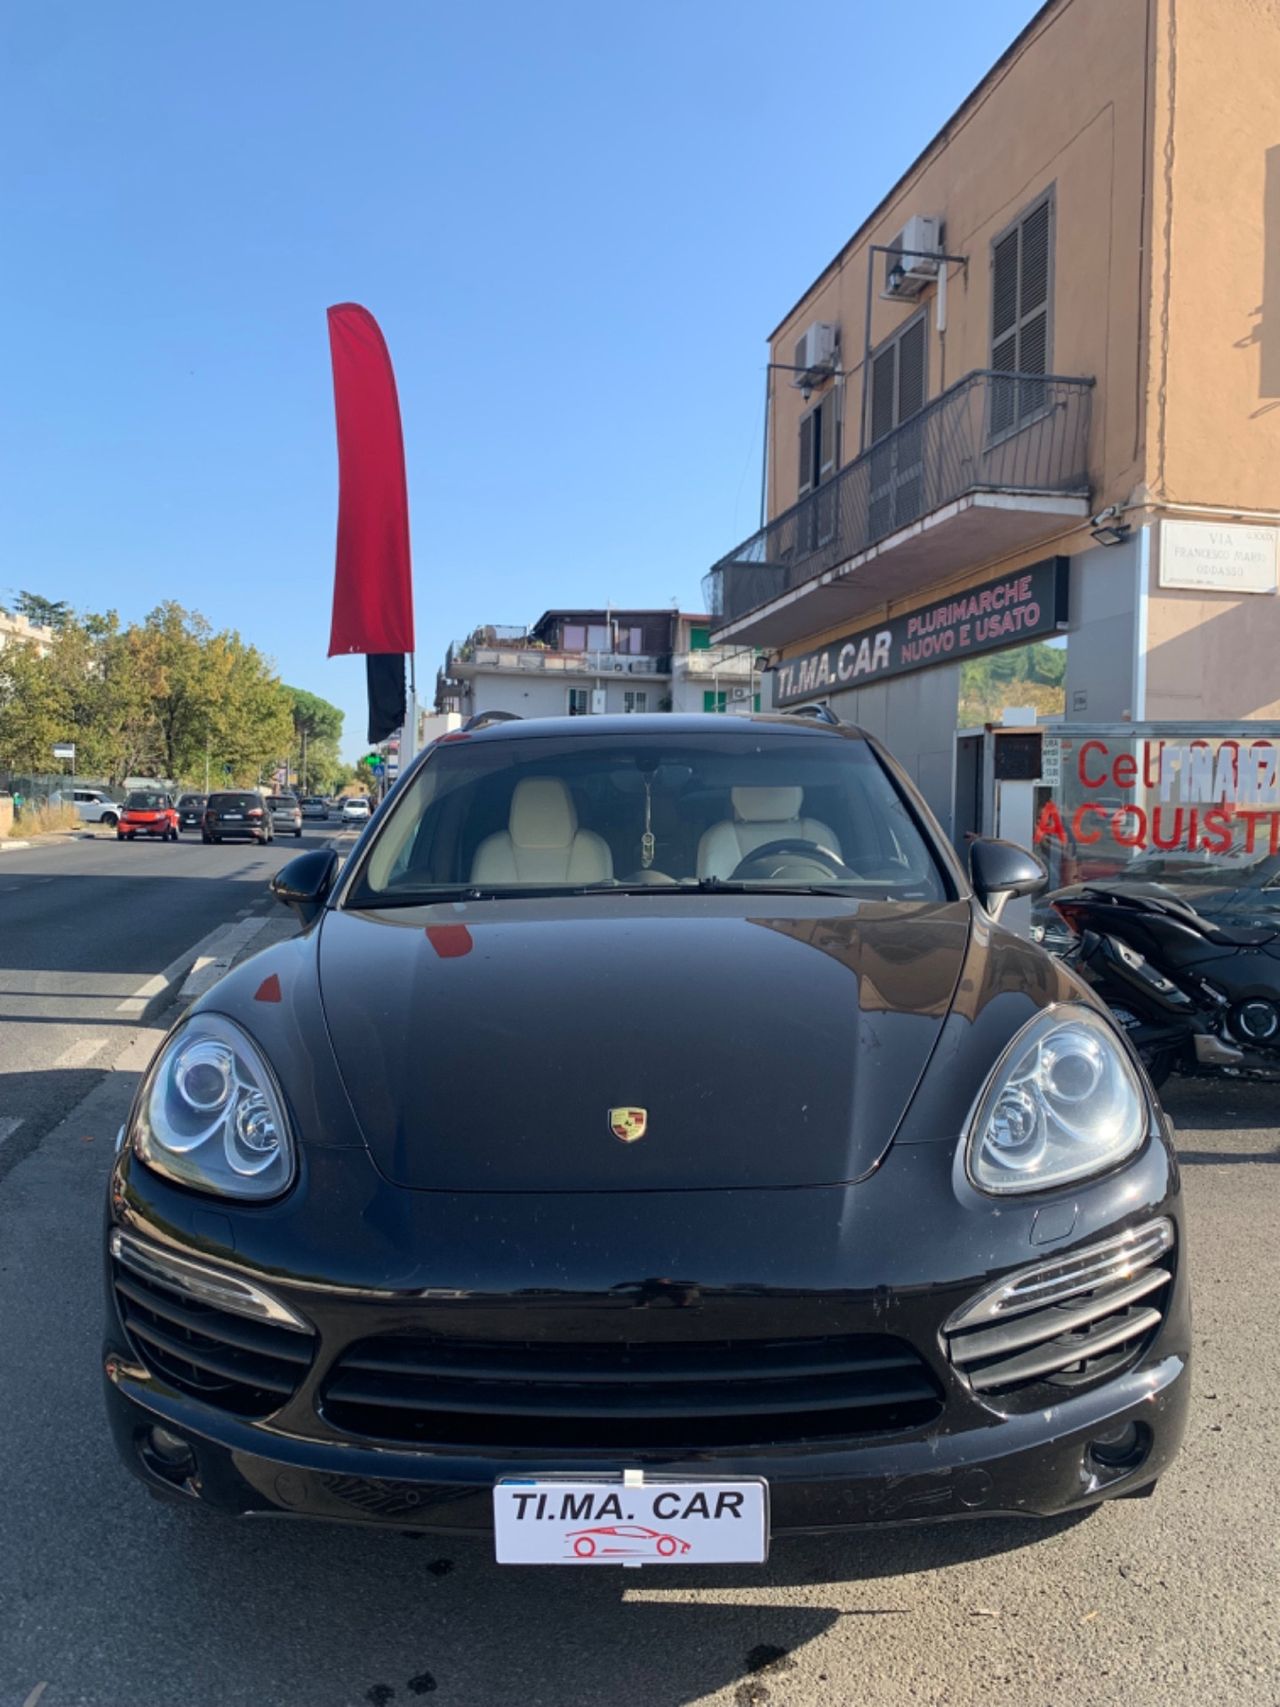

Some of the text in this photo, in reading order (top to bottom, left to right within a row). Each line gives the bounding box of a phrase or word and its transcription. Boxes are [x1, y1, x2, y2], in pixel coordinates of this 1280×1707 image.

[1174, 546, 1231, 560] FRANCESCO
[1209, 533, 1233, 546] VIA
[907, 575, 1032, 639] PLURIMARCHE
[901, 602, 1041, 665] NUOVO E USATO
[1032, 800, 1280, 856] ACQUISTI
[511, 1490, 745, 1521] TI.MA. CAR
